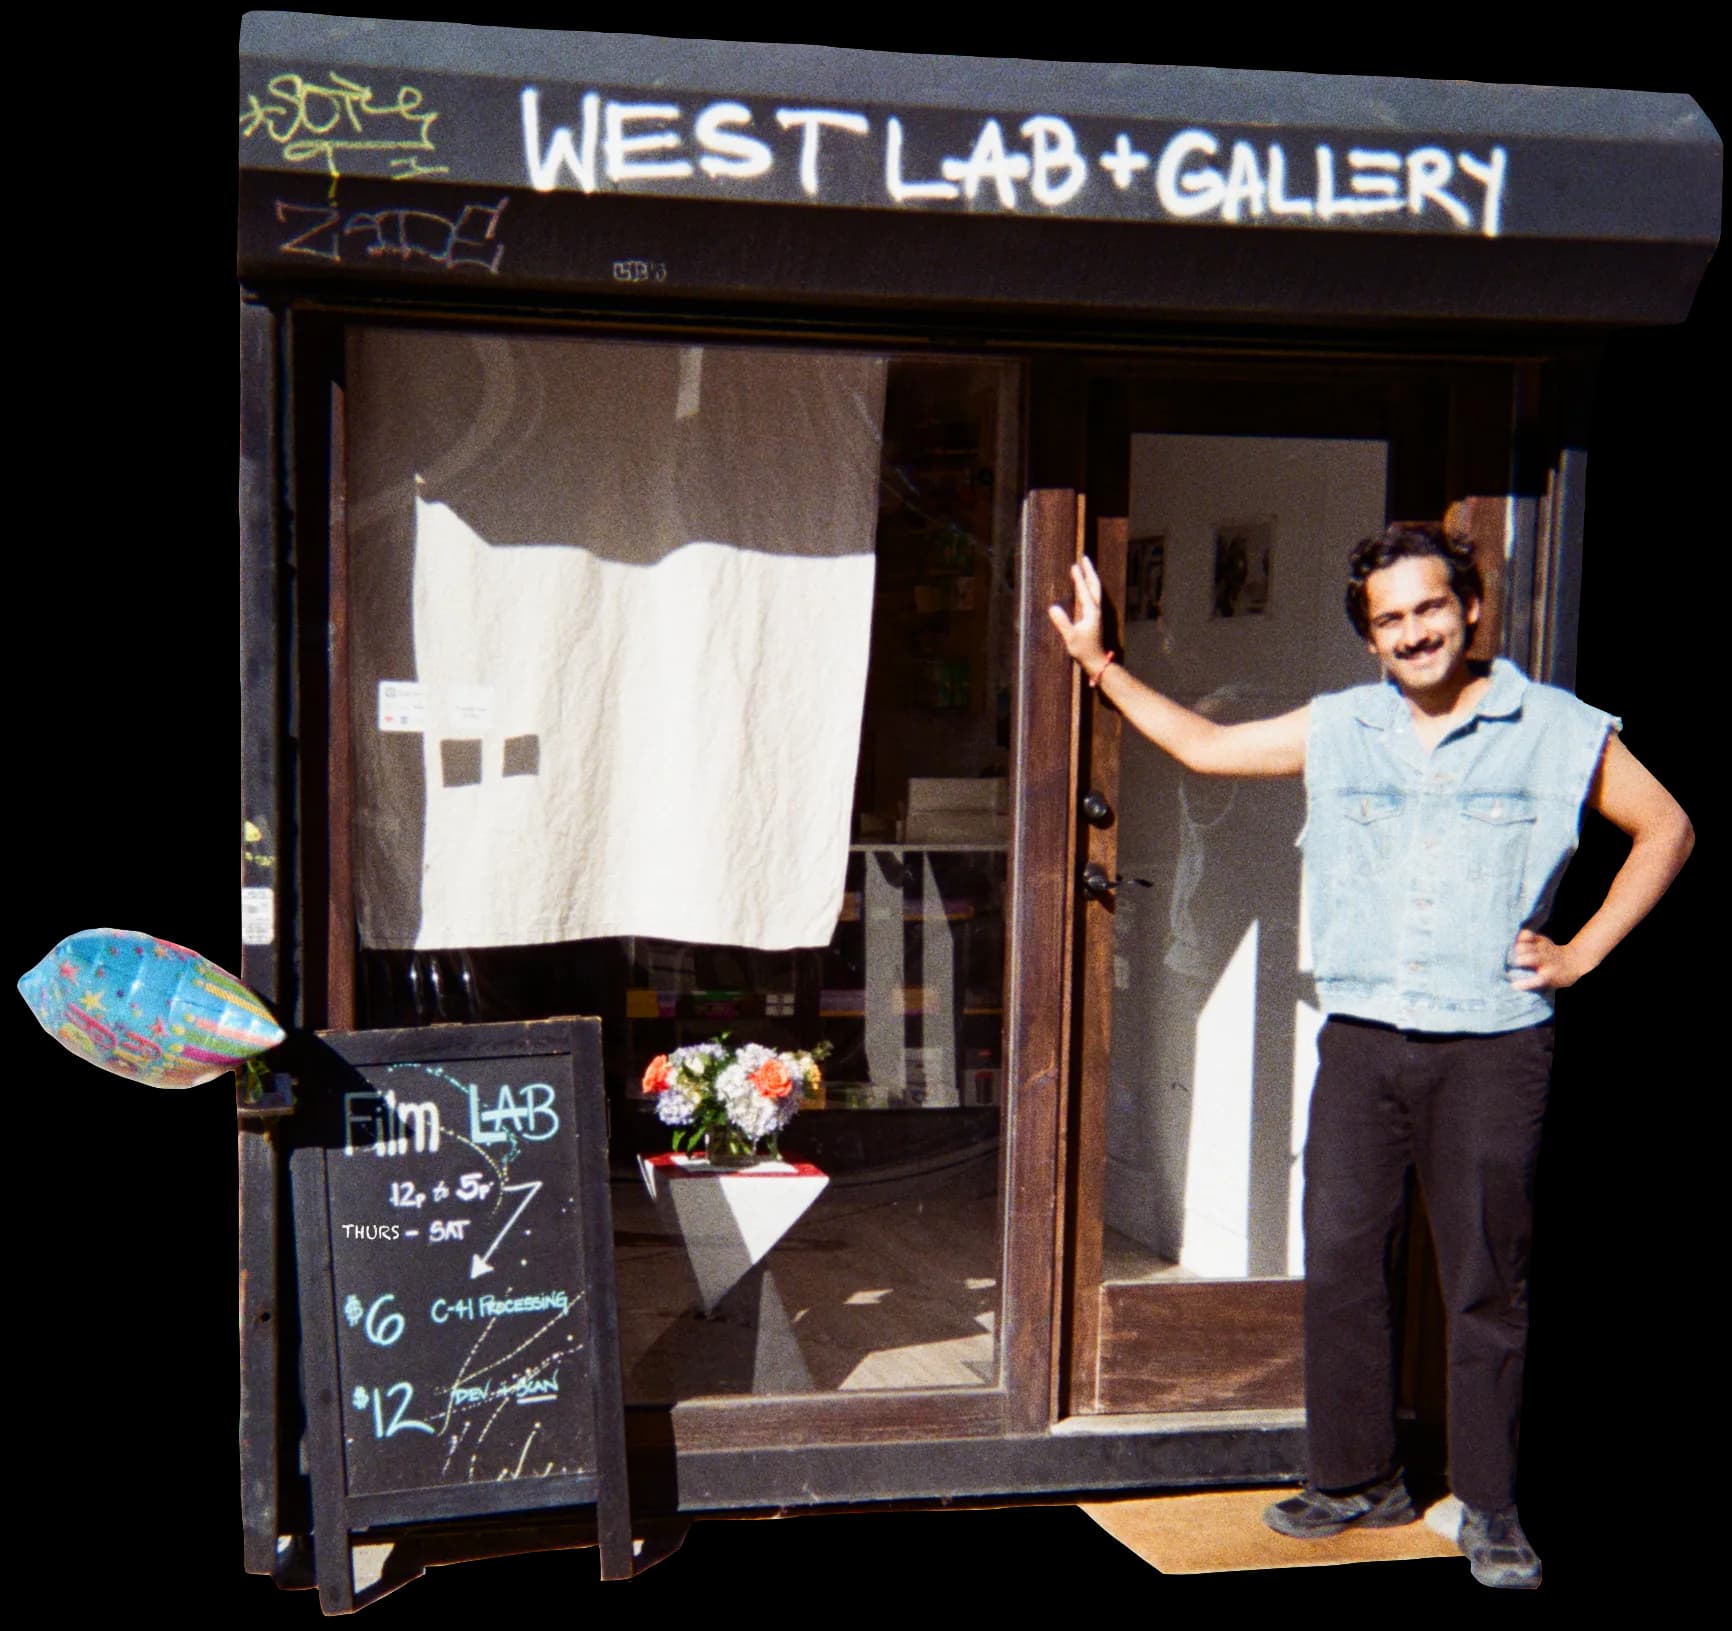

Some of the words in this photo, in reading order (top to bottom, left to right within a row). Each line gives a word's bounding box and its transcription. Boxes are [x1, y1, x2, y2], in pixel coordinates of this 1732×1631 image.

[520, 87, 868, 194] WEST
[885, 116, 1086, 207] LAB
[1099, 134, 1150, 189] +
[1156, 130, 1508, 237] GALLERY
[469, 1082, 559, 1144] LAB
[341, 1223, 400, 1241] THURS
[429, 1219, 472, 1242] SAT
[430, 1298, 474, 1324] C-41
[352, 1381, 436, 1439] $12
